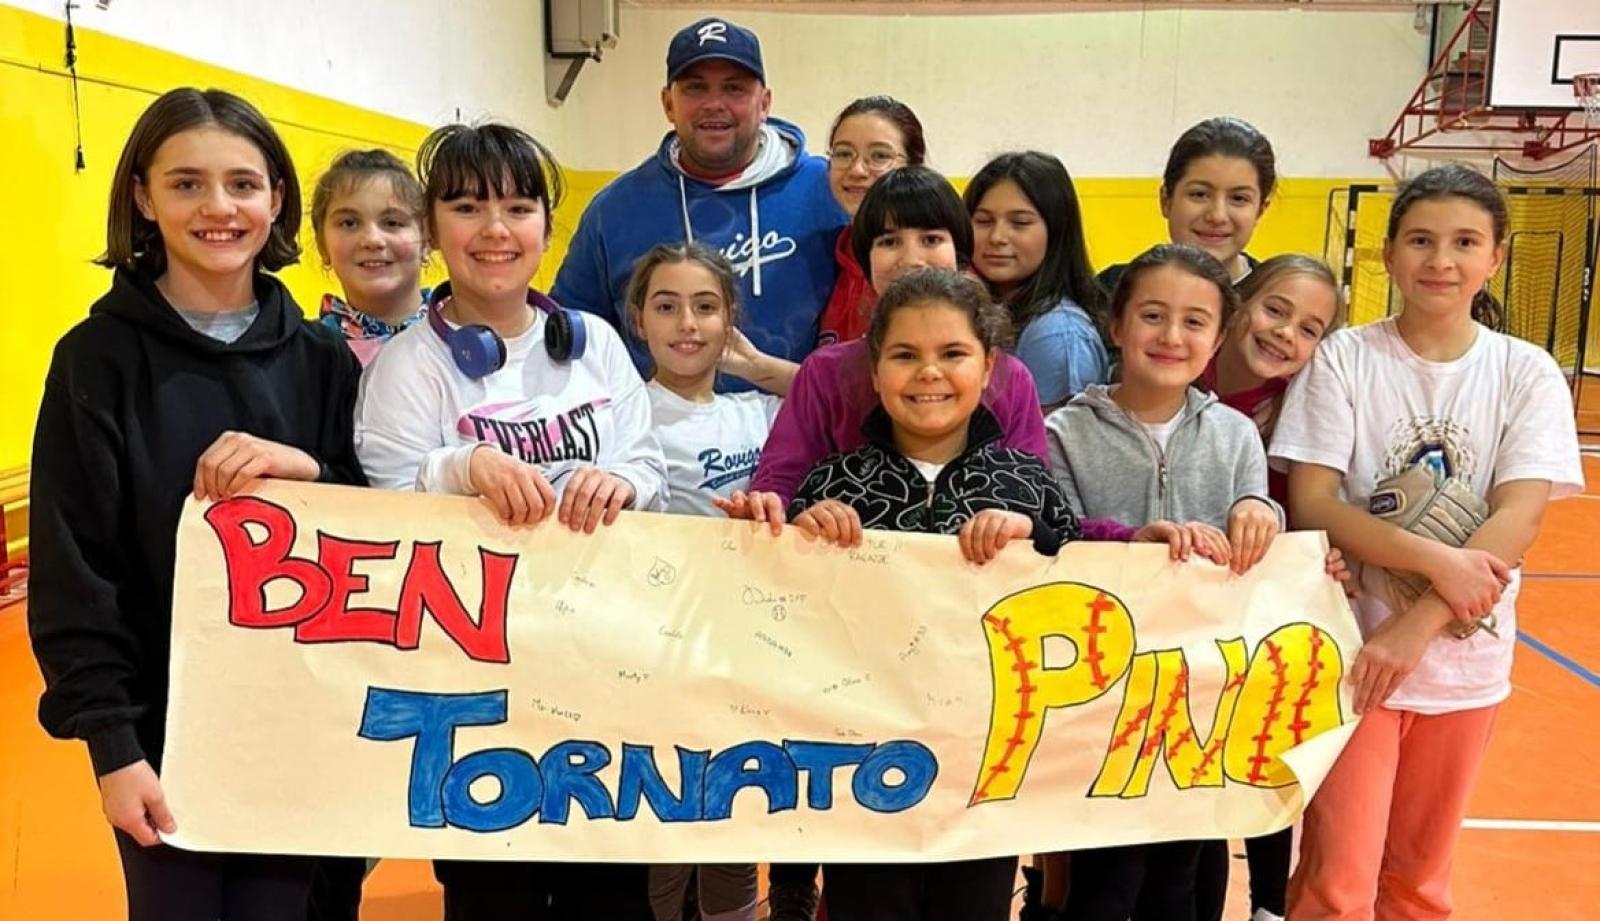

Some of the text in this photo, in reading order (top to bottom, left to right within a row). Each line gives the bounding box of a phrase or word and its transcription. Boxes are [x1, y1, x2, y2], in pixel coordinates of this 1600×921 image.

[697, 22, 727, 46] R
[719, 230, 797, 277] igo
[203, 495, 520, 664] BEN
[357, 685, 940, 834] TORNATO
[966, 580, 1345, 808] PINO
